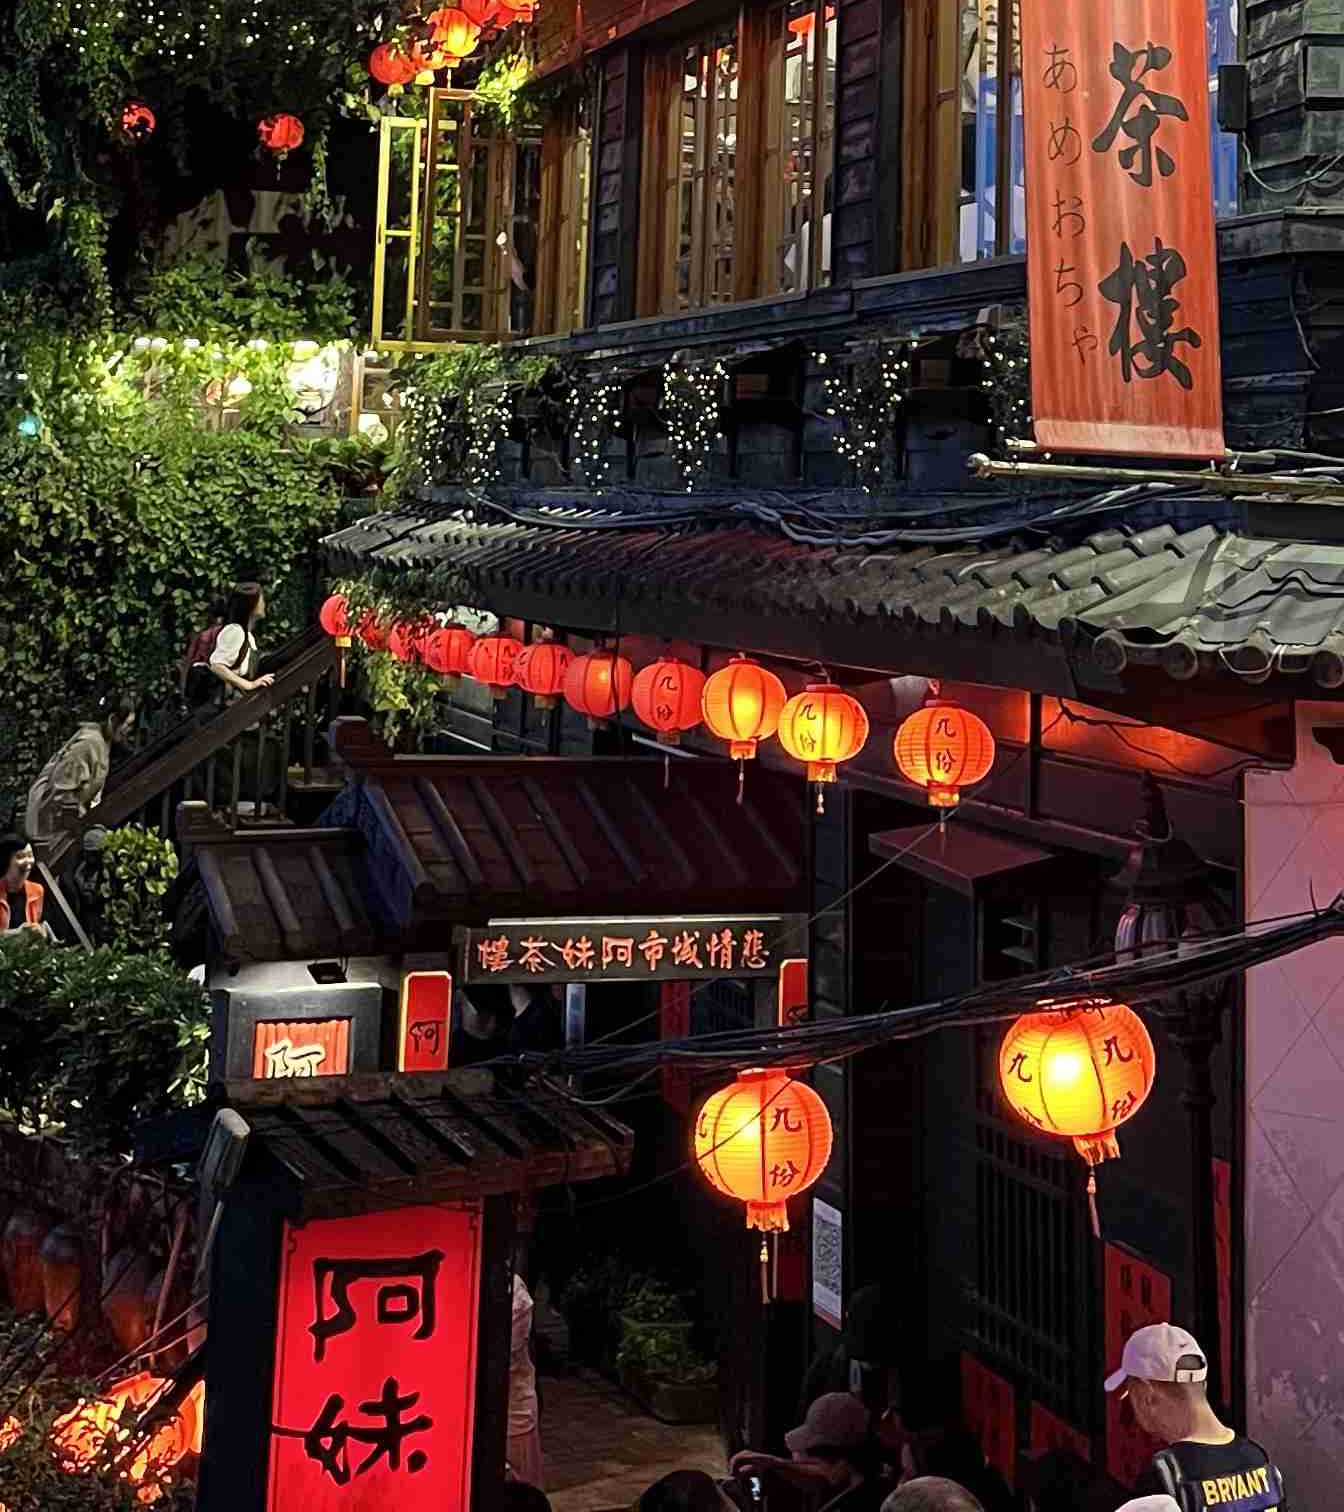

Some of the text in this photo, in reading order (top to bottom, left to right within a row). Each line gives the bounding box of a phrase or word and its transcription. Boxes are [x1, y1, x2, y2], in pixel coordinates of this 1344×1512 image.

[1043, 43, 1100, 362] あめおちゃ
[656, 675, 678, 721] 九份
[799, 703, 816, 753] 九份
[935, 717, 956, 773] 九份
[1102, 1036, 1137, 1120] 九份
[769, 1107, 803, 1187] 九份
[303, 1247, 446, 1487] 阿妹
[1201, 1467, 1271, 1506] BRYANT
